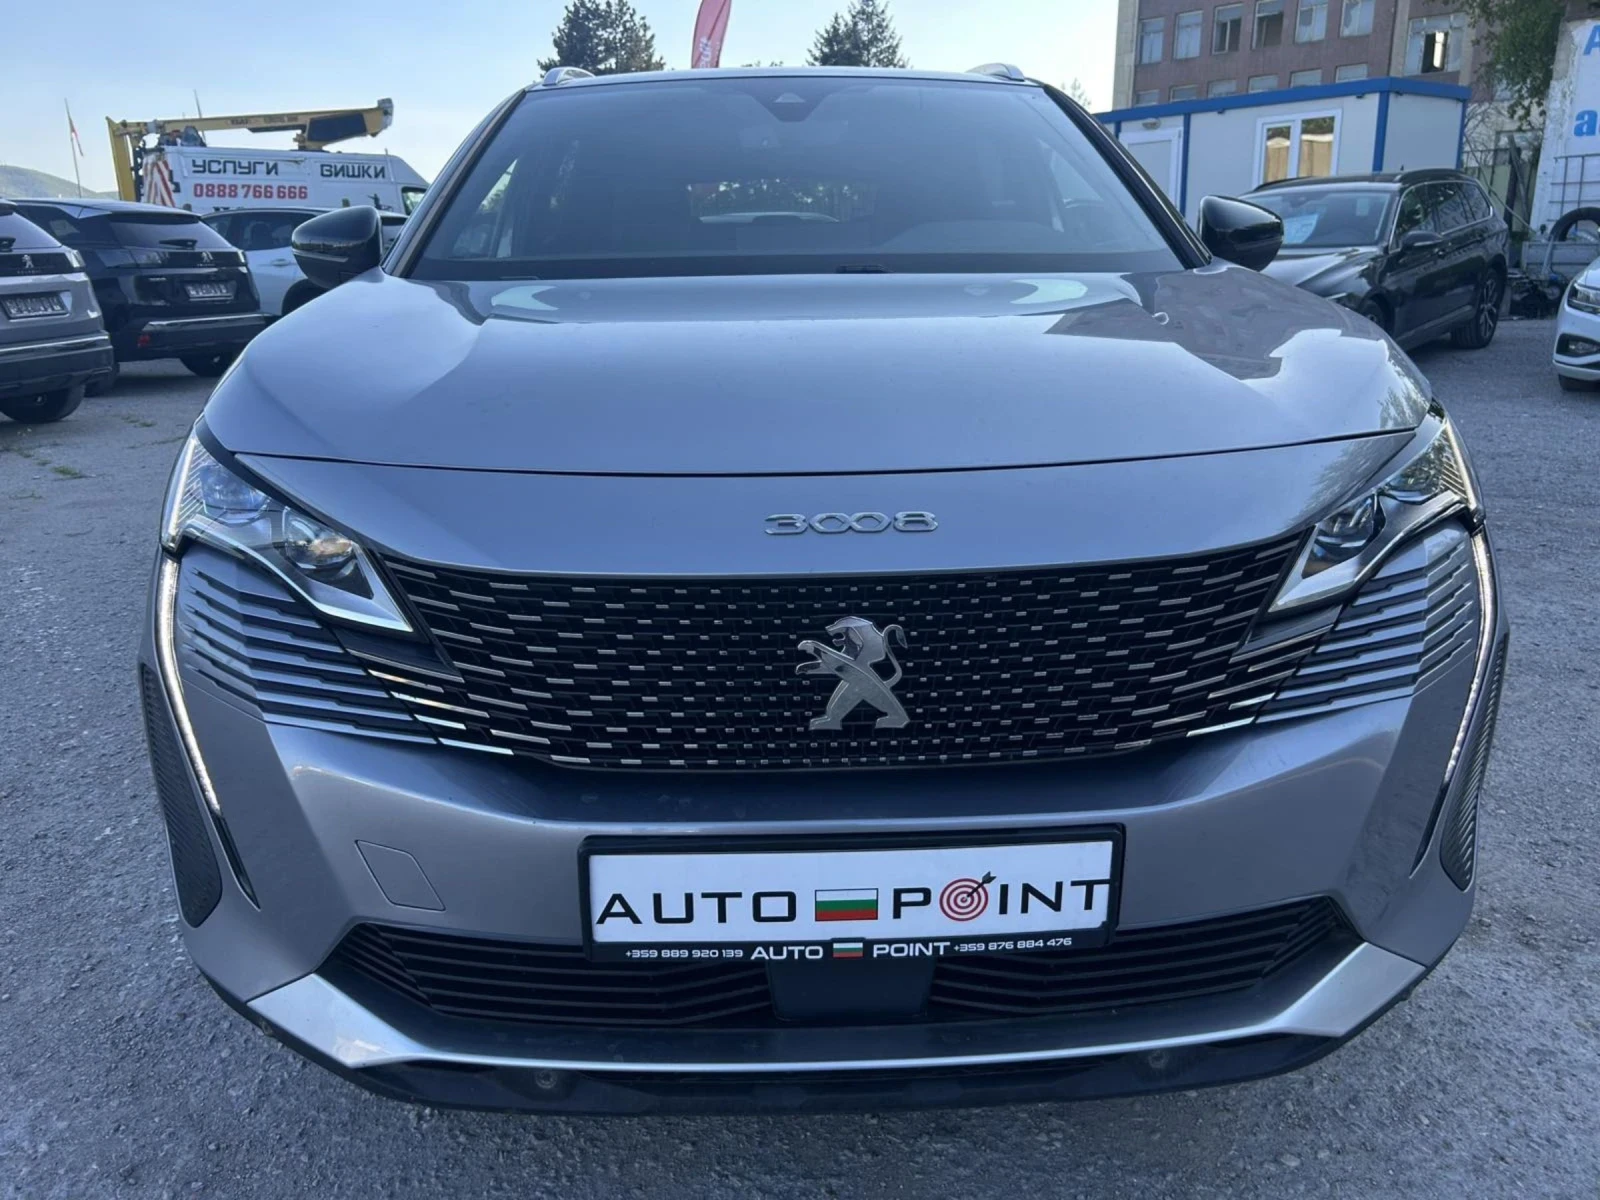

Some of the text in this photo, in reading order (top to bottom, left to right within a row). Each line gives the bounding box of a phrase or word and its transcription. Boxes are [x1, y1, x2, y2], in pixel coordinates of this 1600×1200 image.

[320, 163, 386, 179] ВИШКИ
[765, 511, 938, 535] 3008
[596, 891, 796, 924] AUTO
[625, 937, 1072, 960] +359 889 920 139 AUTO POINT +359 876 884 476
